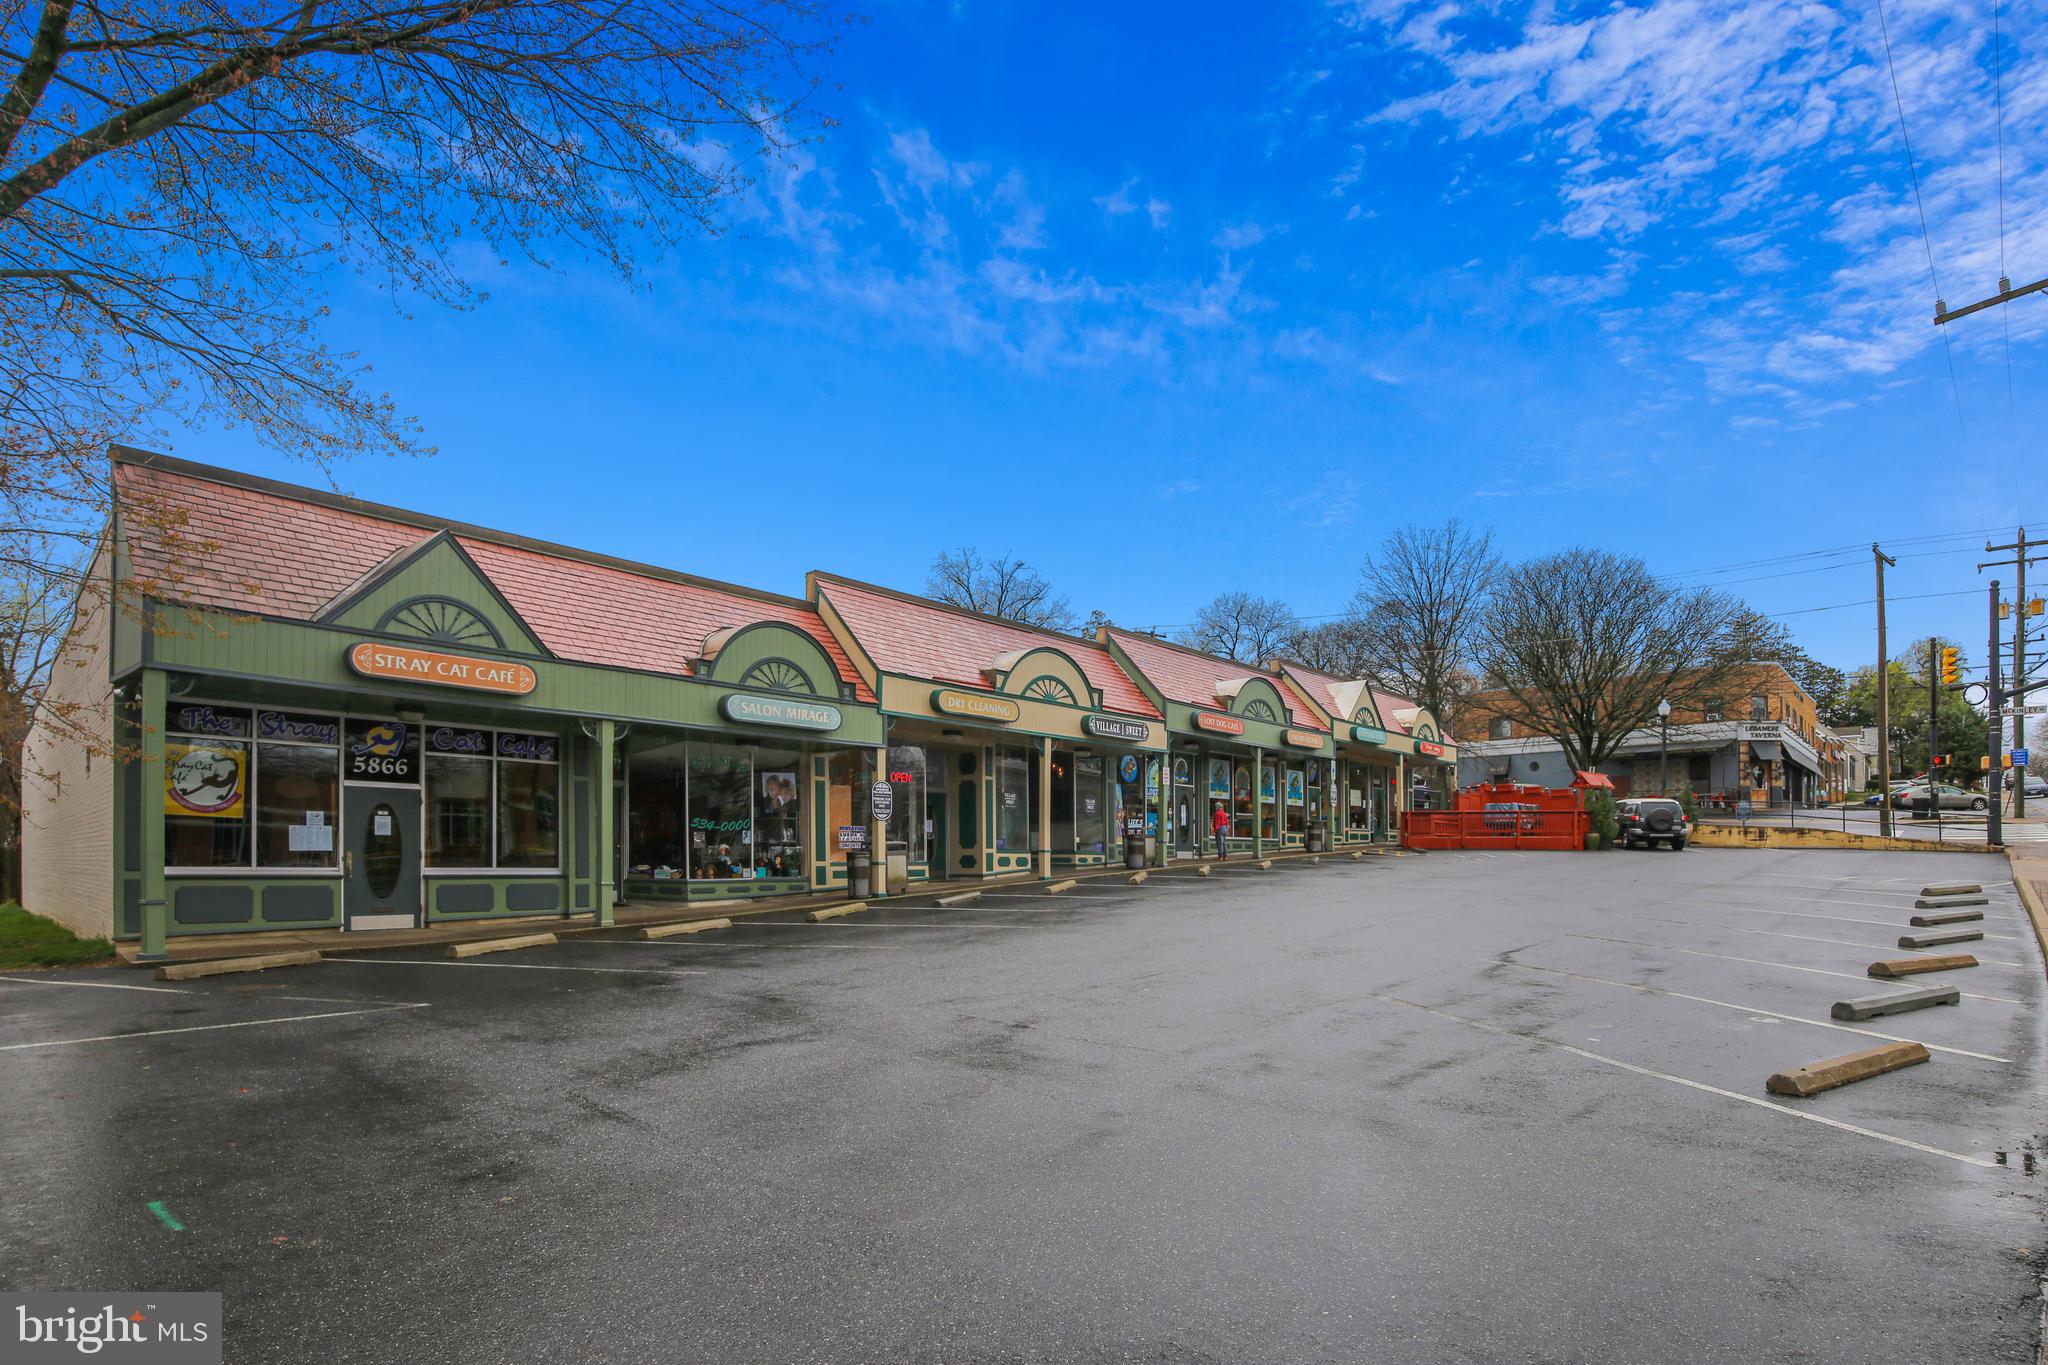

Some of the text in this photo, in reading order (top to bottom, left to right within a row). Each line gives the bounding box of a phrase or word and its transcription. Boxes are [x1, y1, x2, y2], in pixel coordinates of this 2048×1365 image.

[375, 653, 515, 684] STRAY CAT CAFÉ
[741, 701, 830, 723] SALON MIRAGE
[948, 696, 1010, 716] DRY CLEANING
[182, 706, 232, 731] The
[259, 711, 337, 745] Stray
[433, 727, 483, 751] Cat
[1096, 720, 1143, 737] VILLAGE SWEET
[1204, 717, 1216, 727] LOST
[1216, 719, 1228, 729] DOG
[195, 760, 213, 771] Cat
[353, 756, 408, 775] 5866
[890, 771, 913, 783] OPEN
[690, 817, 751, 831] 534-0000
